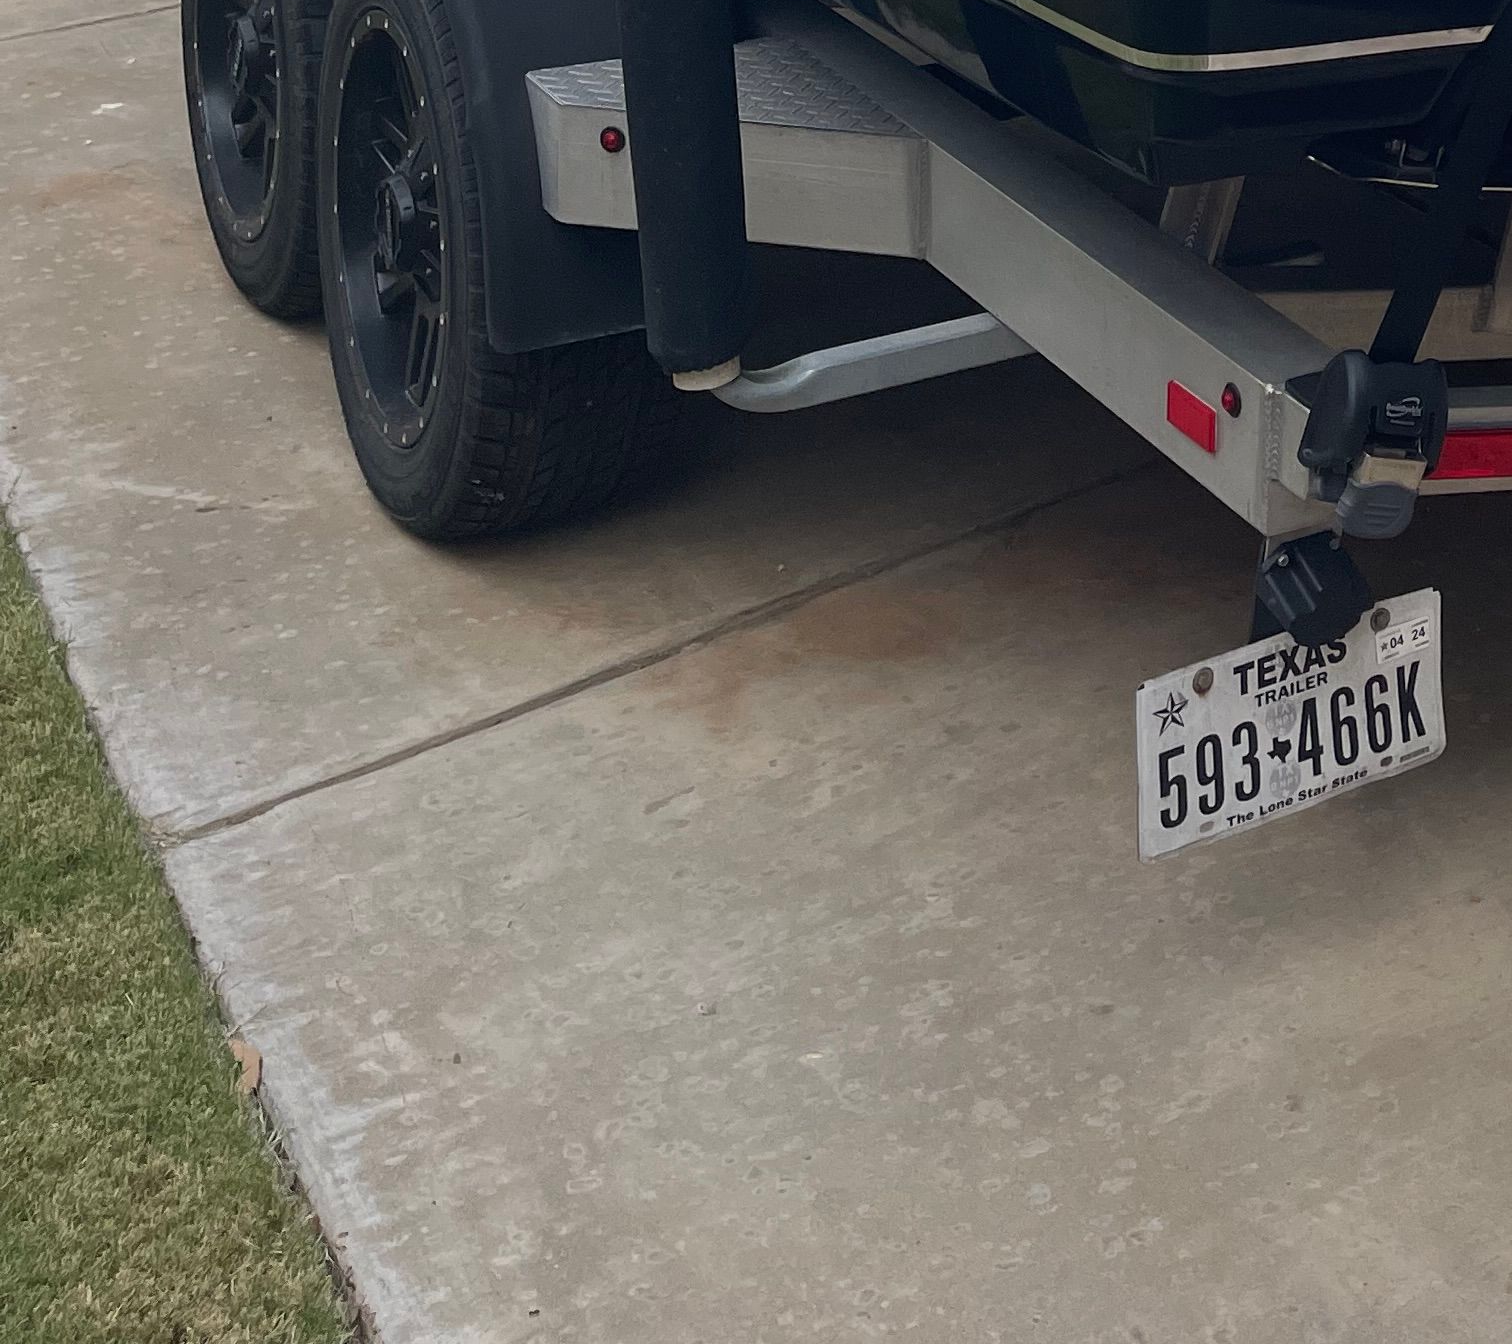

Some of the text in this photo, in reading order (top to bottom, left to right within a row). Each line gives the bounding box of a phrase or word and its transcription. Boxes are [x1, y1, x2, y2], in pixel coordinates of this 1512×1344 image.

[1390, 633, 1405, 649] 04
[1411, 625, 1426, 641] 24
[1233, 640, 1347, 696] TEXAS
[1254, 671, 1329, 708] TRAILER
[1158, 660, 1427, 829] 593 466K
[1226, 768, 1369, 827] The Lone Star State
